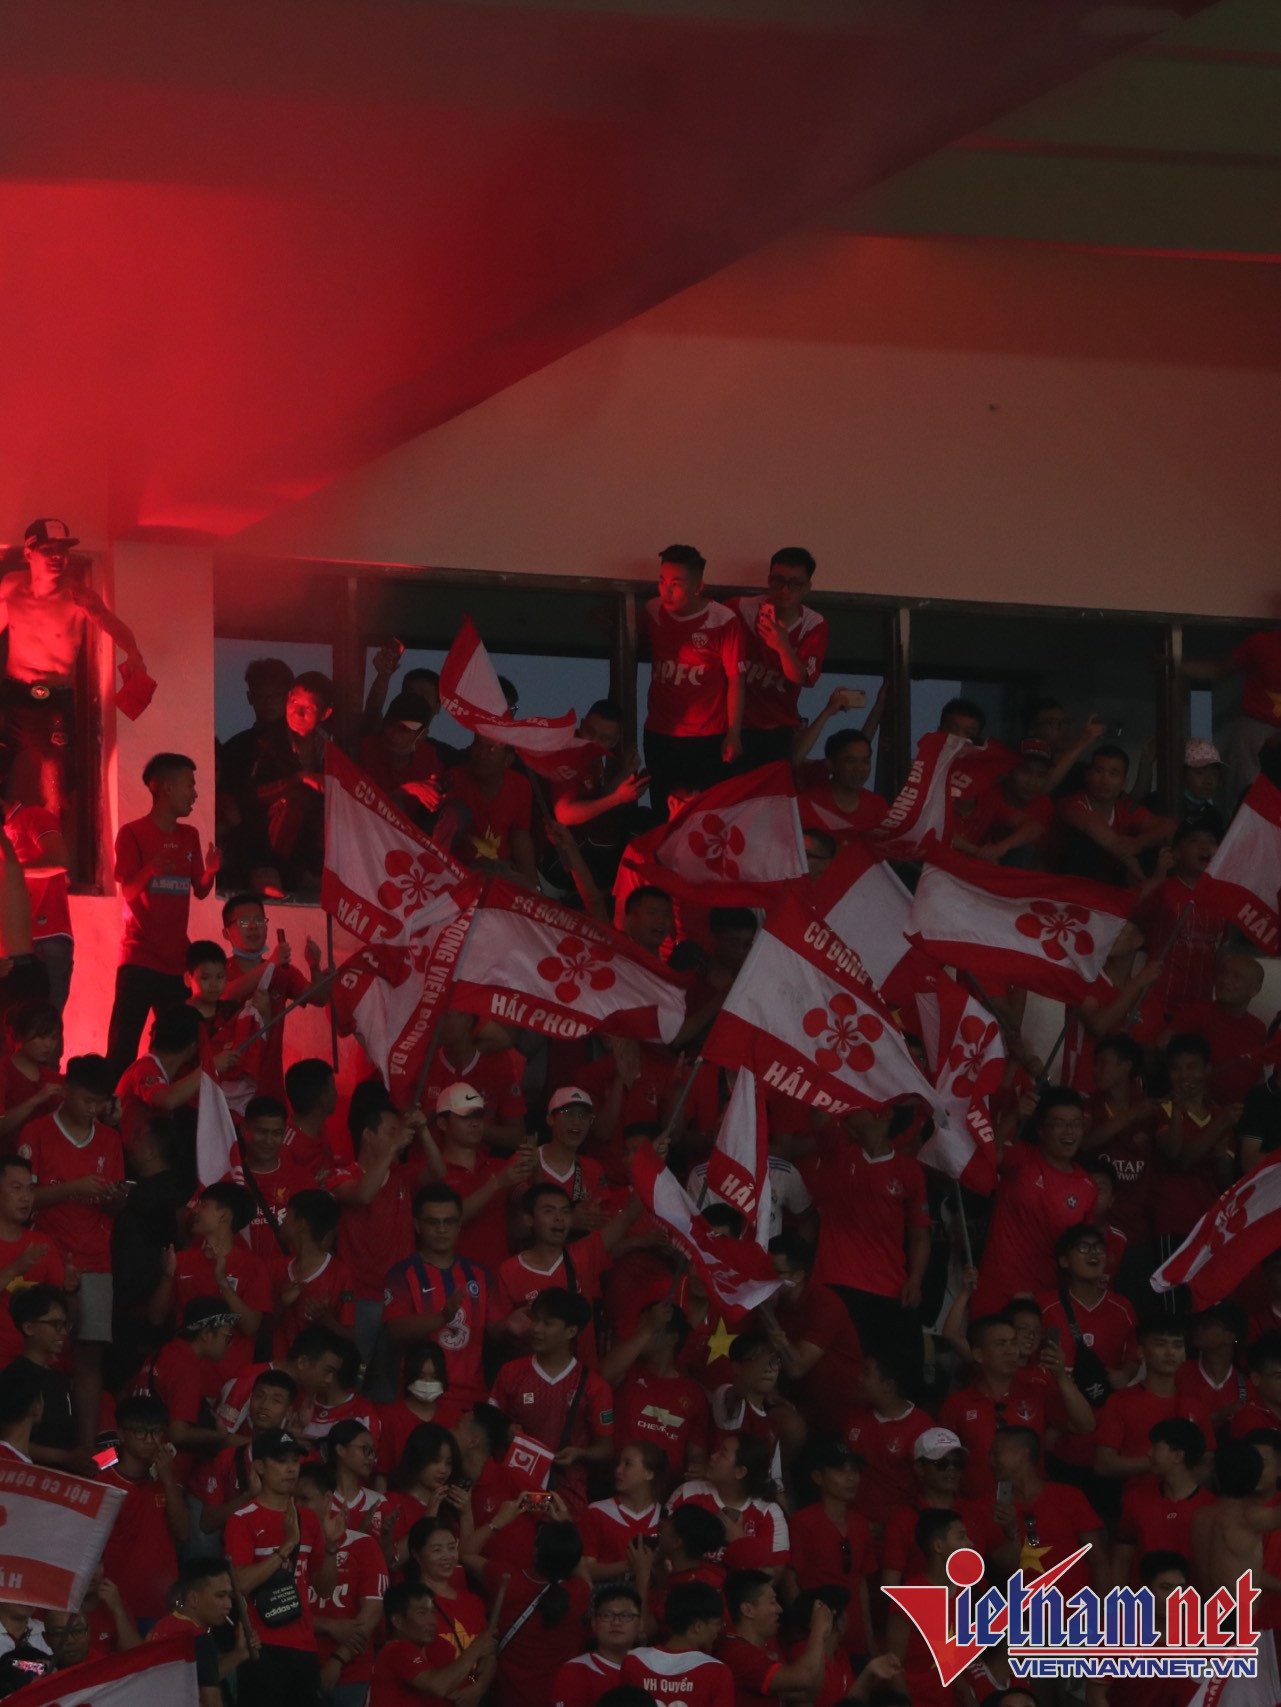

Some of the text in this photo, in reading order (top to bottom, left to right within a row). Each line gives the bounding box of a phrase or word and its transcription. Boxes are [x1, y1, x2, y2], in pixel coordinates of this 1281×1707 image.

[337, 896, 370, 936] HẢI
[1236, 904, 1279, 945] HẢI
[422, 964, 451, 1006] VIÊN
[490, 992, 529, 1023] HẢI
[762, 1060, 812, 1100] HẢI
[264, 1605, 291, 1619] adidas
[643, 1677, 658, 1692] VH
